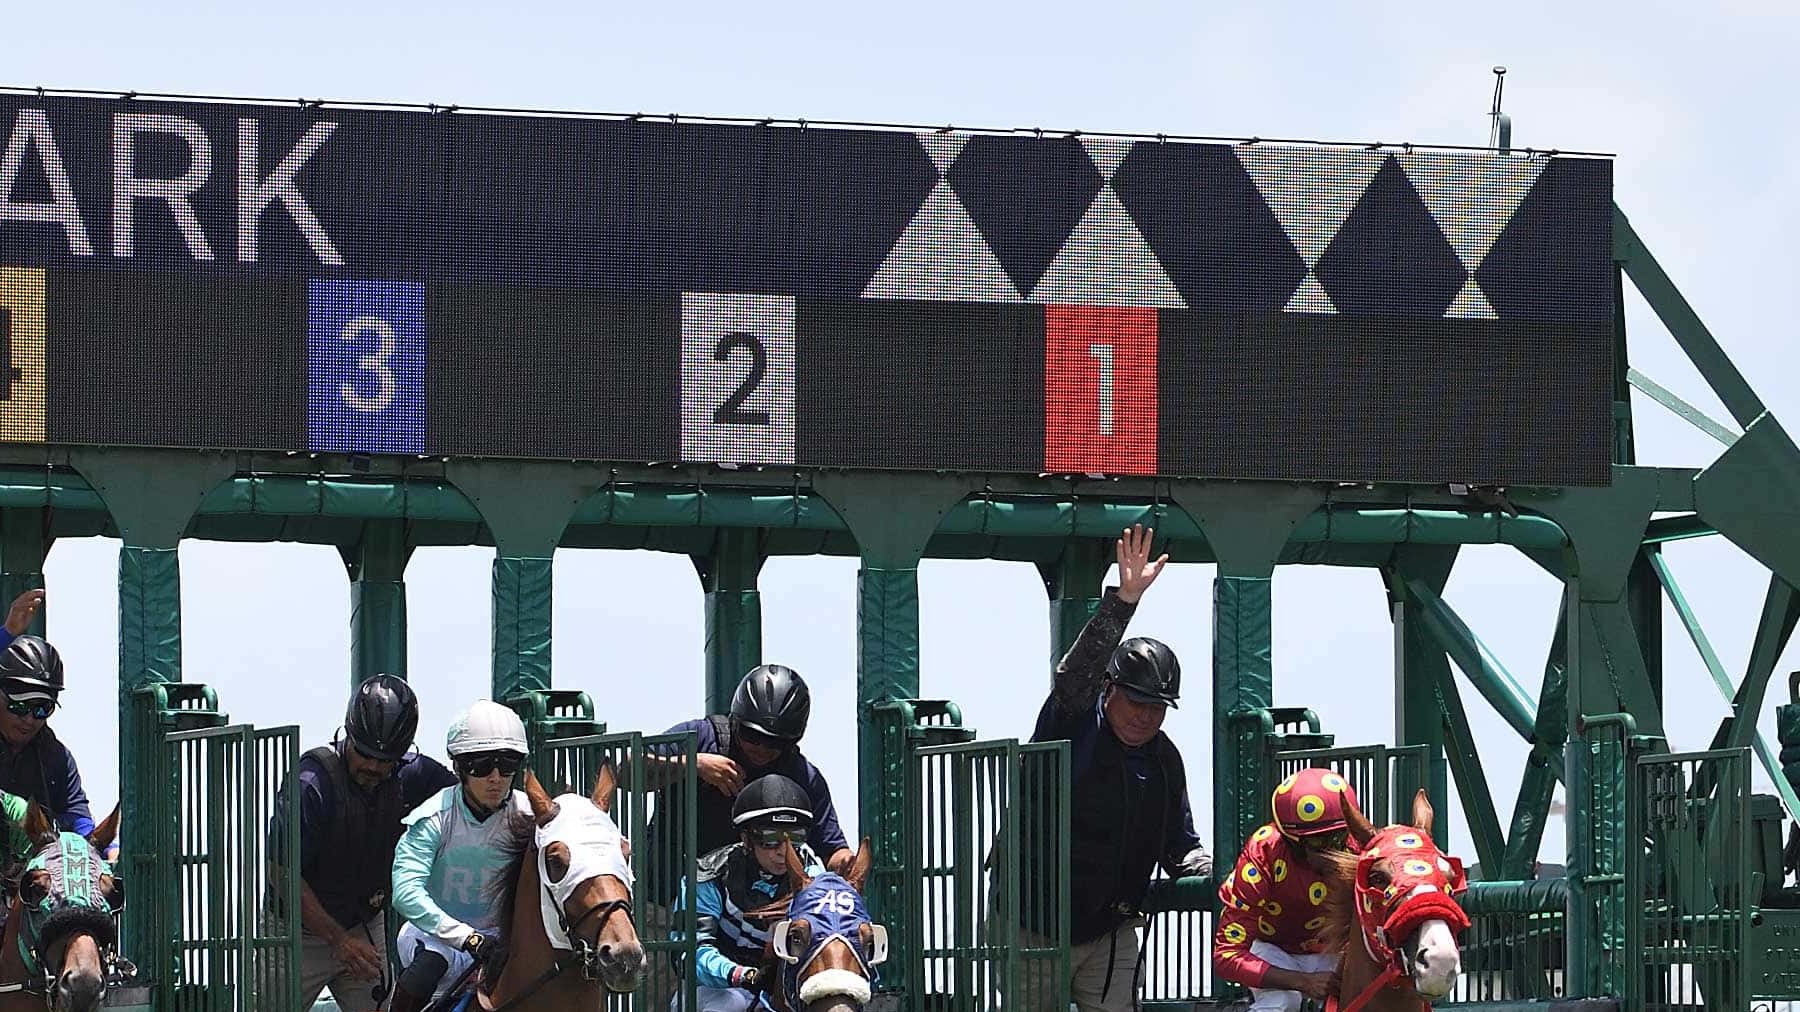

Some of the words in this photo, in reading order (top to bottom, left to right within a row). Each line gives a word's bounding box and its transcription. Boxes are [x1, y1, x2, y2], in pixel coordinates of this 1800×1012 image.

[340, 315, 397, 413] 3
[711, 331, 772, 426] 2
[1091, 345, 1114, 436] 1
[65, 839, 89, 896] LMM
[814, 889, 856, 915] AS
